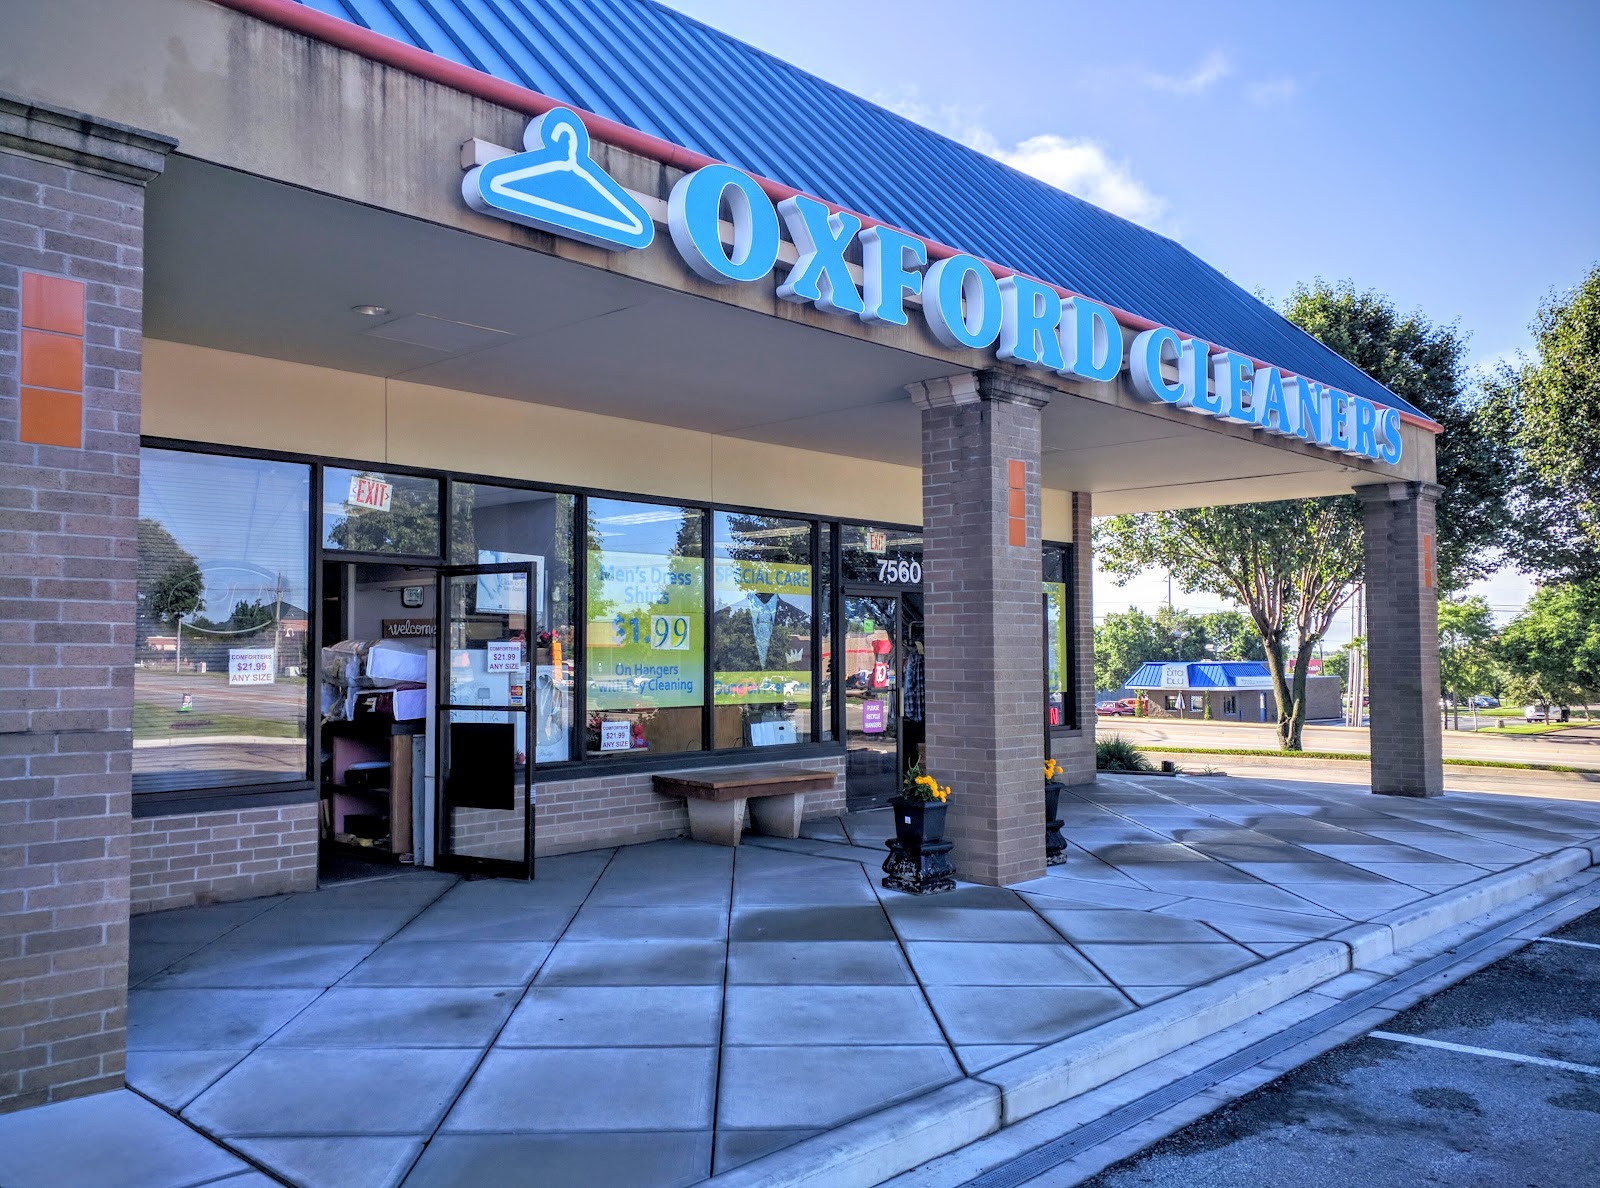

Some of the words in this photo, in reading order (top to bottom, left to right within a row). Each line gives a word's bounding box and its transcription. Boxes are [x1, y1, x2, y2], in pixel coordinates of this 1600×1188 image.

[667, 163, 1124, 383] OXFORD
[1129, 326, 1403, 465] CLEANERS
[356, 480, 388, 507] EXIT
[870, 534, 884, 551] EXIT
[600, 564, 647, 584] Men's
[650, 567, 692, 586] Dress
[715, 566, 773, 586] SPECIAL
[774, 569, 810, 588] CARE
[877, 559, 922, 584] 7560
[624, 585, 670, 605] Shirts
[388, 619, 437, 636] welcome
[610, 613, 689, 649] $1.99
[493, 653, 516, 661] $21.99
[236, 662, 267, 672] $21.99
[615, 664, 632, 676] On
[634, 664, 679, 679] Hangers
[231, 674, 251, 682] ANY
[252, 673, 272, 682] SIZE
[598, 679, 624, 692] with
[647, 678, 693, 693] Cleaning
